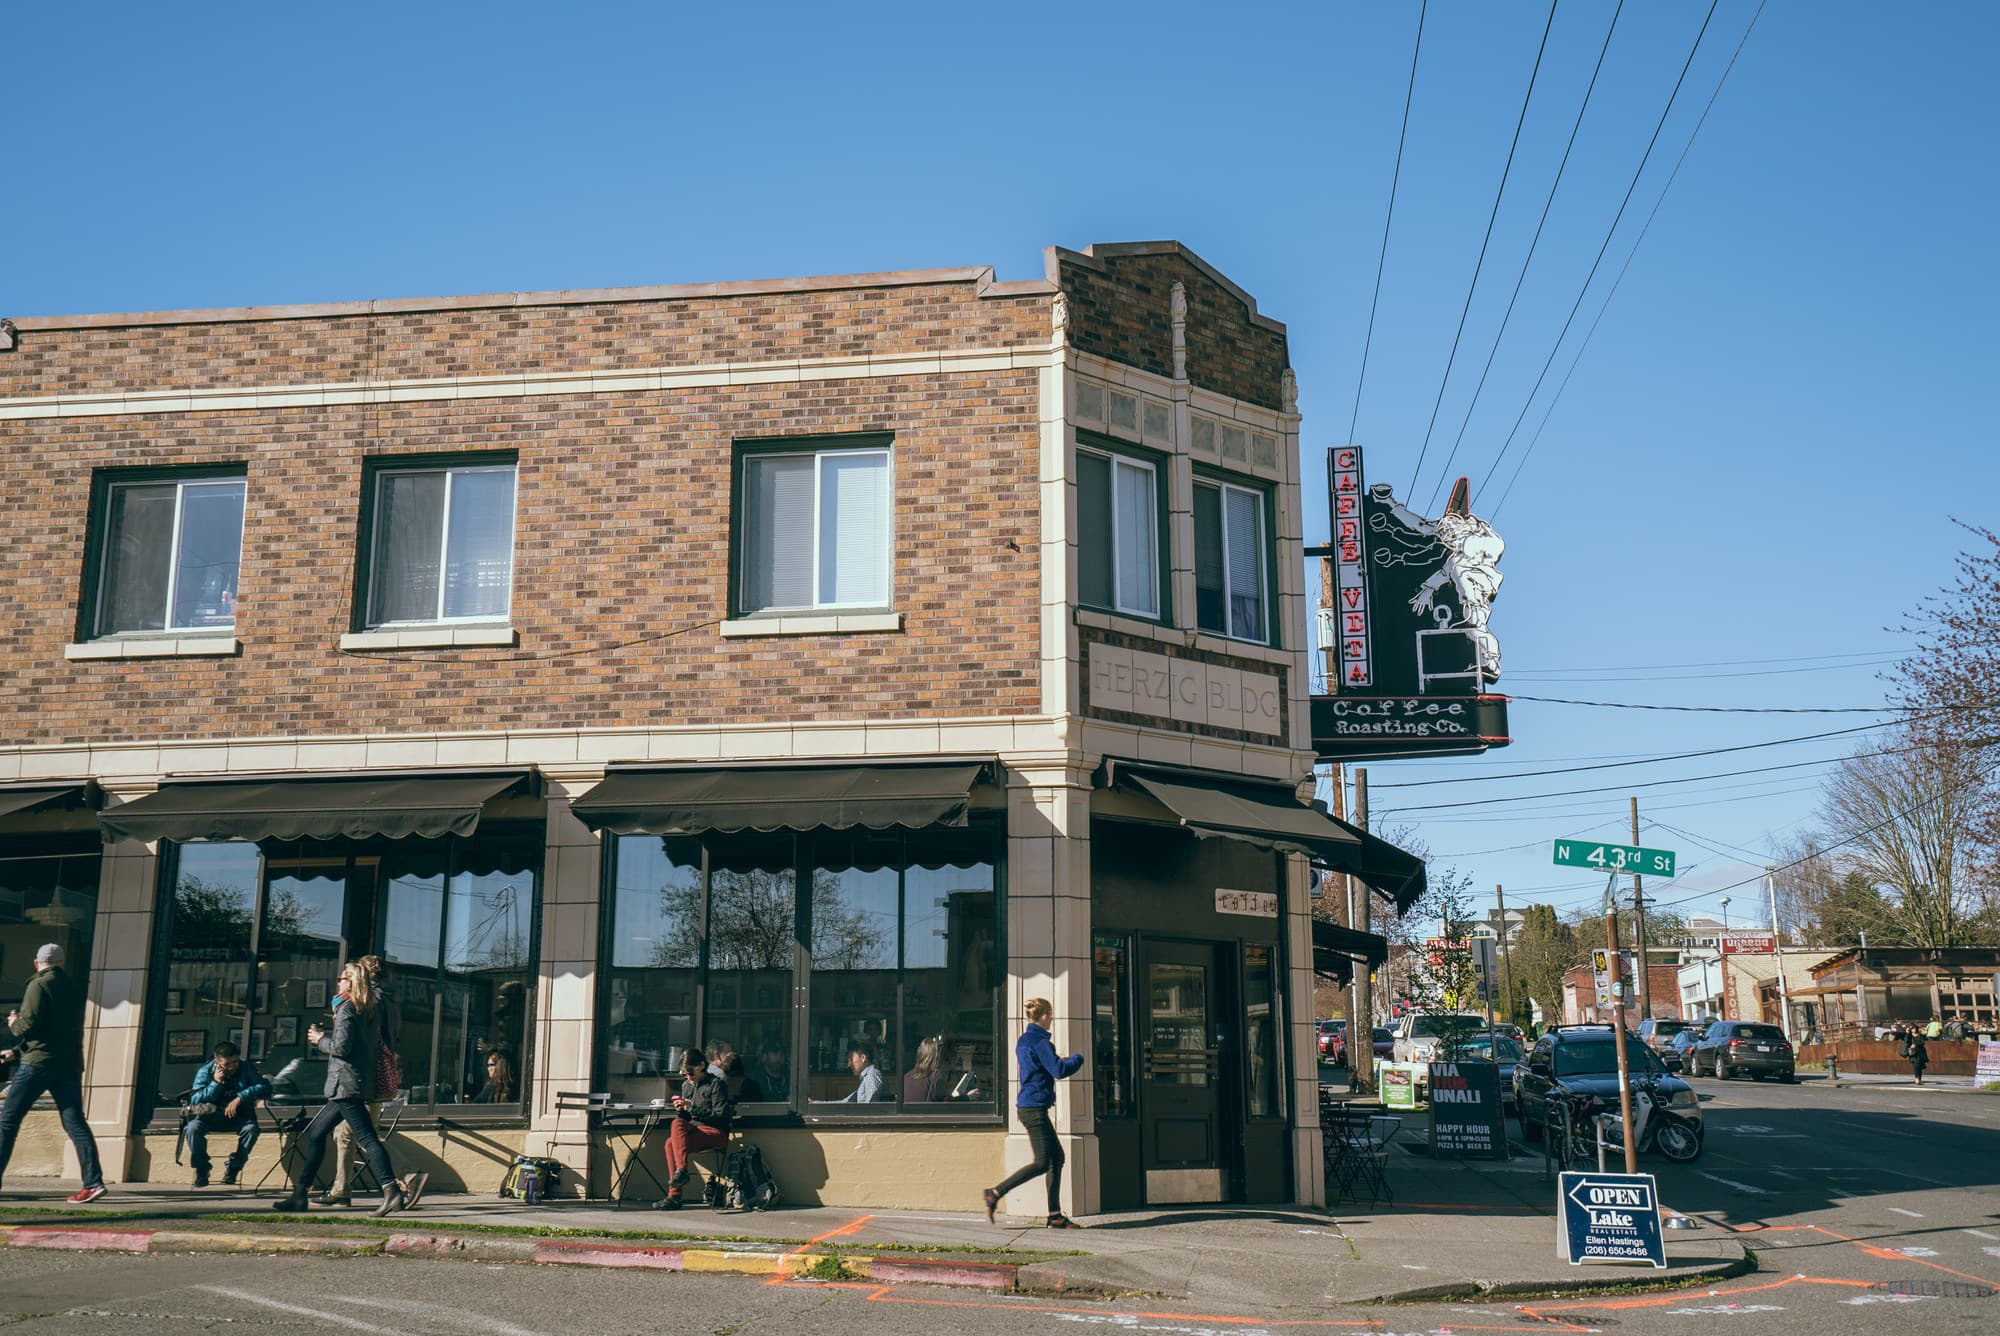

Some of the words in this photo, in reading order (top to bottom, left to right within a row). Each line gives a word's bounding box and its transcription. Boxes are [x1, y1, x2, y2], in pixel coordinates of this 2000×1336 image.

[1337, 451, 1361, 562] CAFFE
[1092, 659, 1197, 706] HERZIG
[1209, 680, 1278, 718] BLDG
[1333, 700, 1466, 716] Coffee
[1335, 719, 1430, 736] Roasting
[1435, 719, 1468, 734] Co.
[1558, 845, 1570, 860] N
[1586, 846, 1641, 869] 43rd
[1653, 855, 1671, 872] St
[1431, 1063, 1460, 1077] VIA
[1433, 1089, 1480, 1104] UNALI
[1436, 1124, 1463, 1134] HAPPY
[1466, 1125, 1490, 1135] HOUR
[1589, 1187, 1640, 1205] OPEN
[1590, 1210, 1633, 1226] Lake
[1585, 1236, 1606, 1245] Ellen
[1608, 1236, 1644, 1247] Hastings
[1585, 1246, 1607, 1255] (206)
